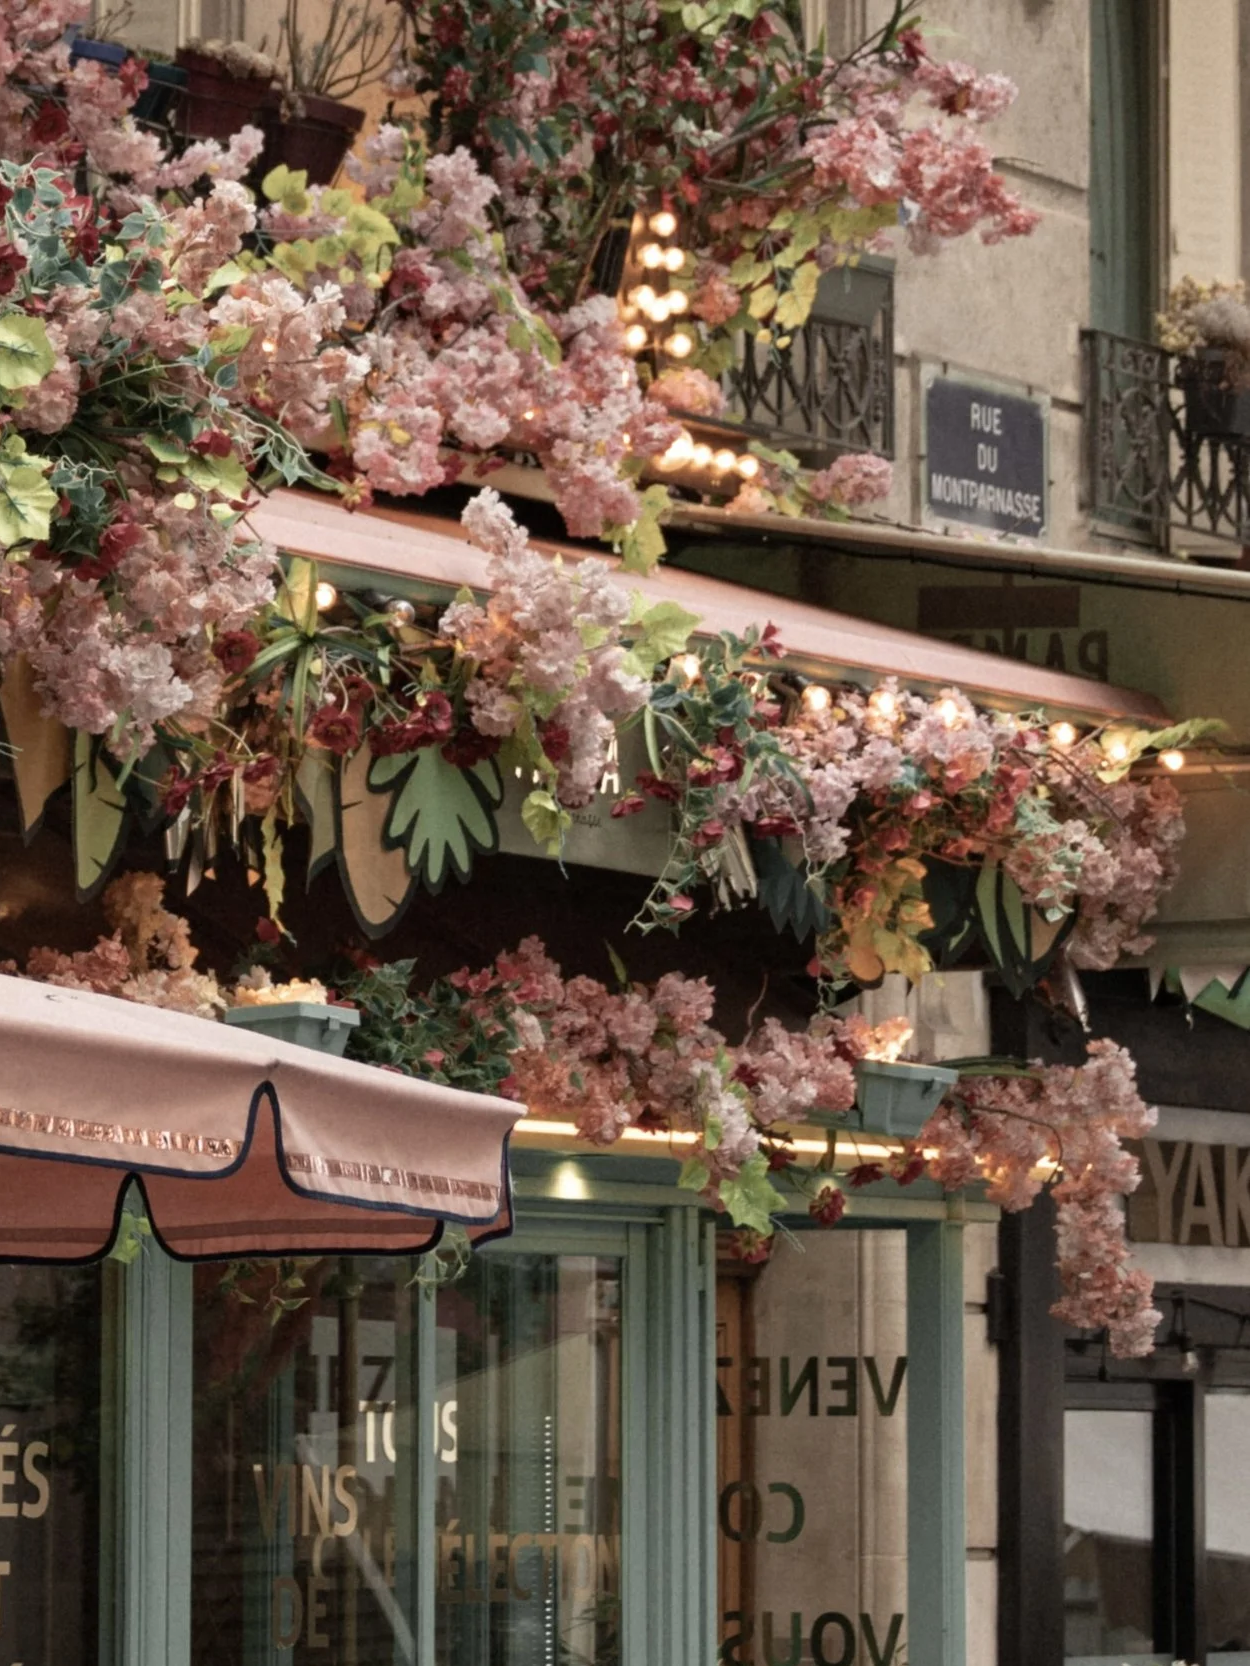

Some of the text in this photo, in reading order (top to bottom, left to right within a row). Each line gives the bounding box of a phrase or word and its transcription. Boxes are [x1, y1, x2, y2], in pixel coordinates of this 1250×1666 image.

[970, 402, 1003, 436] RUE
[976, 442, 999, 475] DU
[930, 471, 1042, 523] MONTPARNASSE
[251, 1463, 359, 1538] VINS
[271, 1575, 331, 1651] DE
